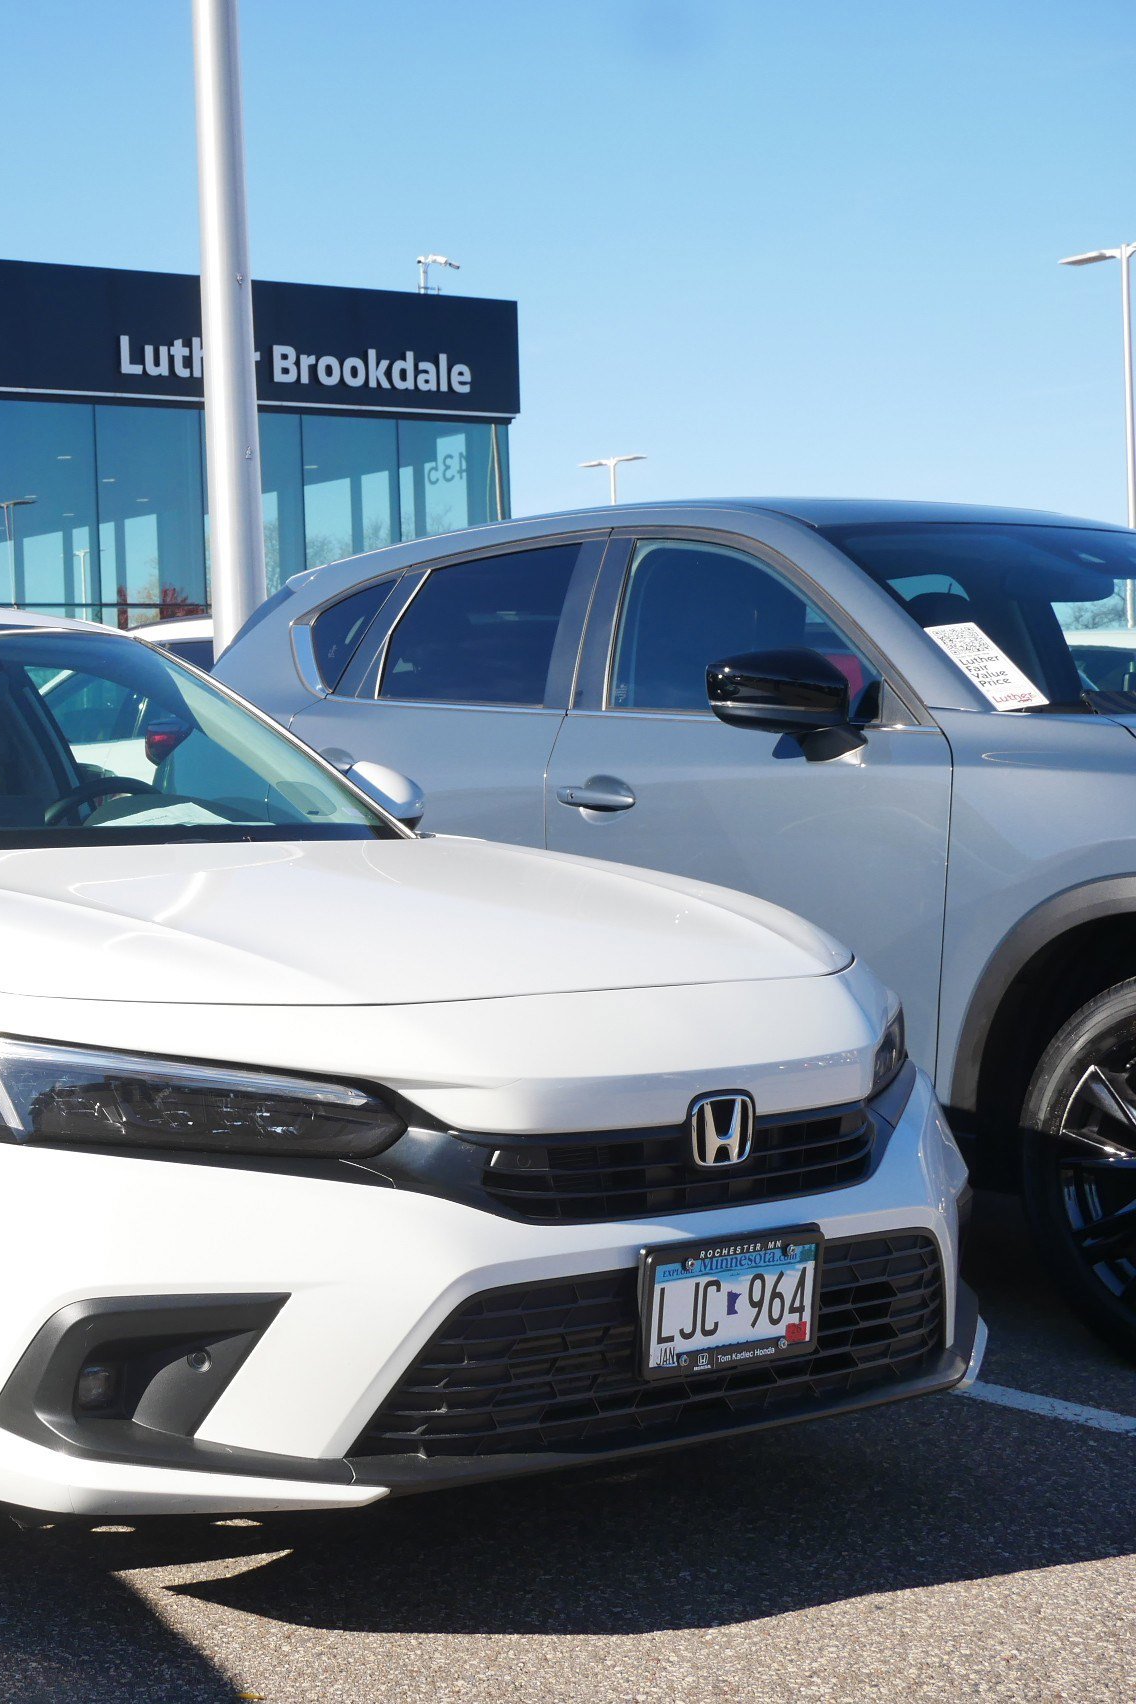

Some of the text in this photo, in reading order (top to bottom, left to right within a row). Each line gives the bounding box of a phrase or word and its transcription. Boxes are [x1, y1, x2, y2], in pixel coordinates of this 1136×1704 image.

[119, 334, 472, 394] Luth Brookdale
[958, 655, 1000, 666] Luther
[965, 664, 989, 673] Fair
[971, 670, 1009, 679] Value
[978, 678, 1012, 687] Price
[992, 692, 1033, 704] Luther
[767, 1240, 782, 1250] MN
[657, 1266, 807, 1345] LJC 964
[655, 1346, 677, 1366] JAN
[717, 1354, 732, 1363] Tom
[754, 1346, 775, 1357] Honda
